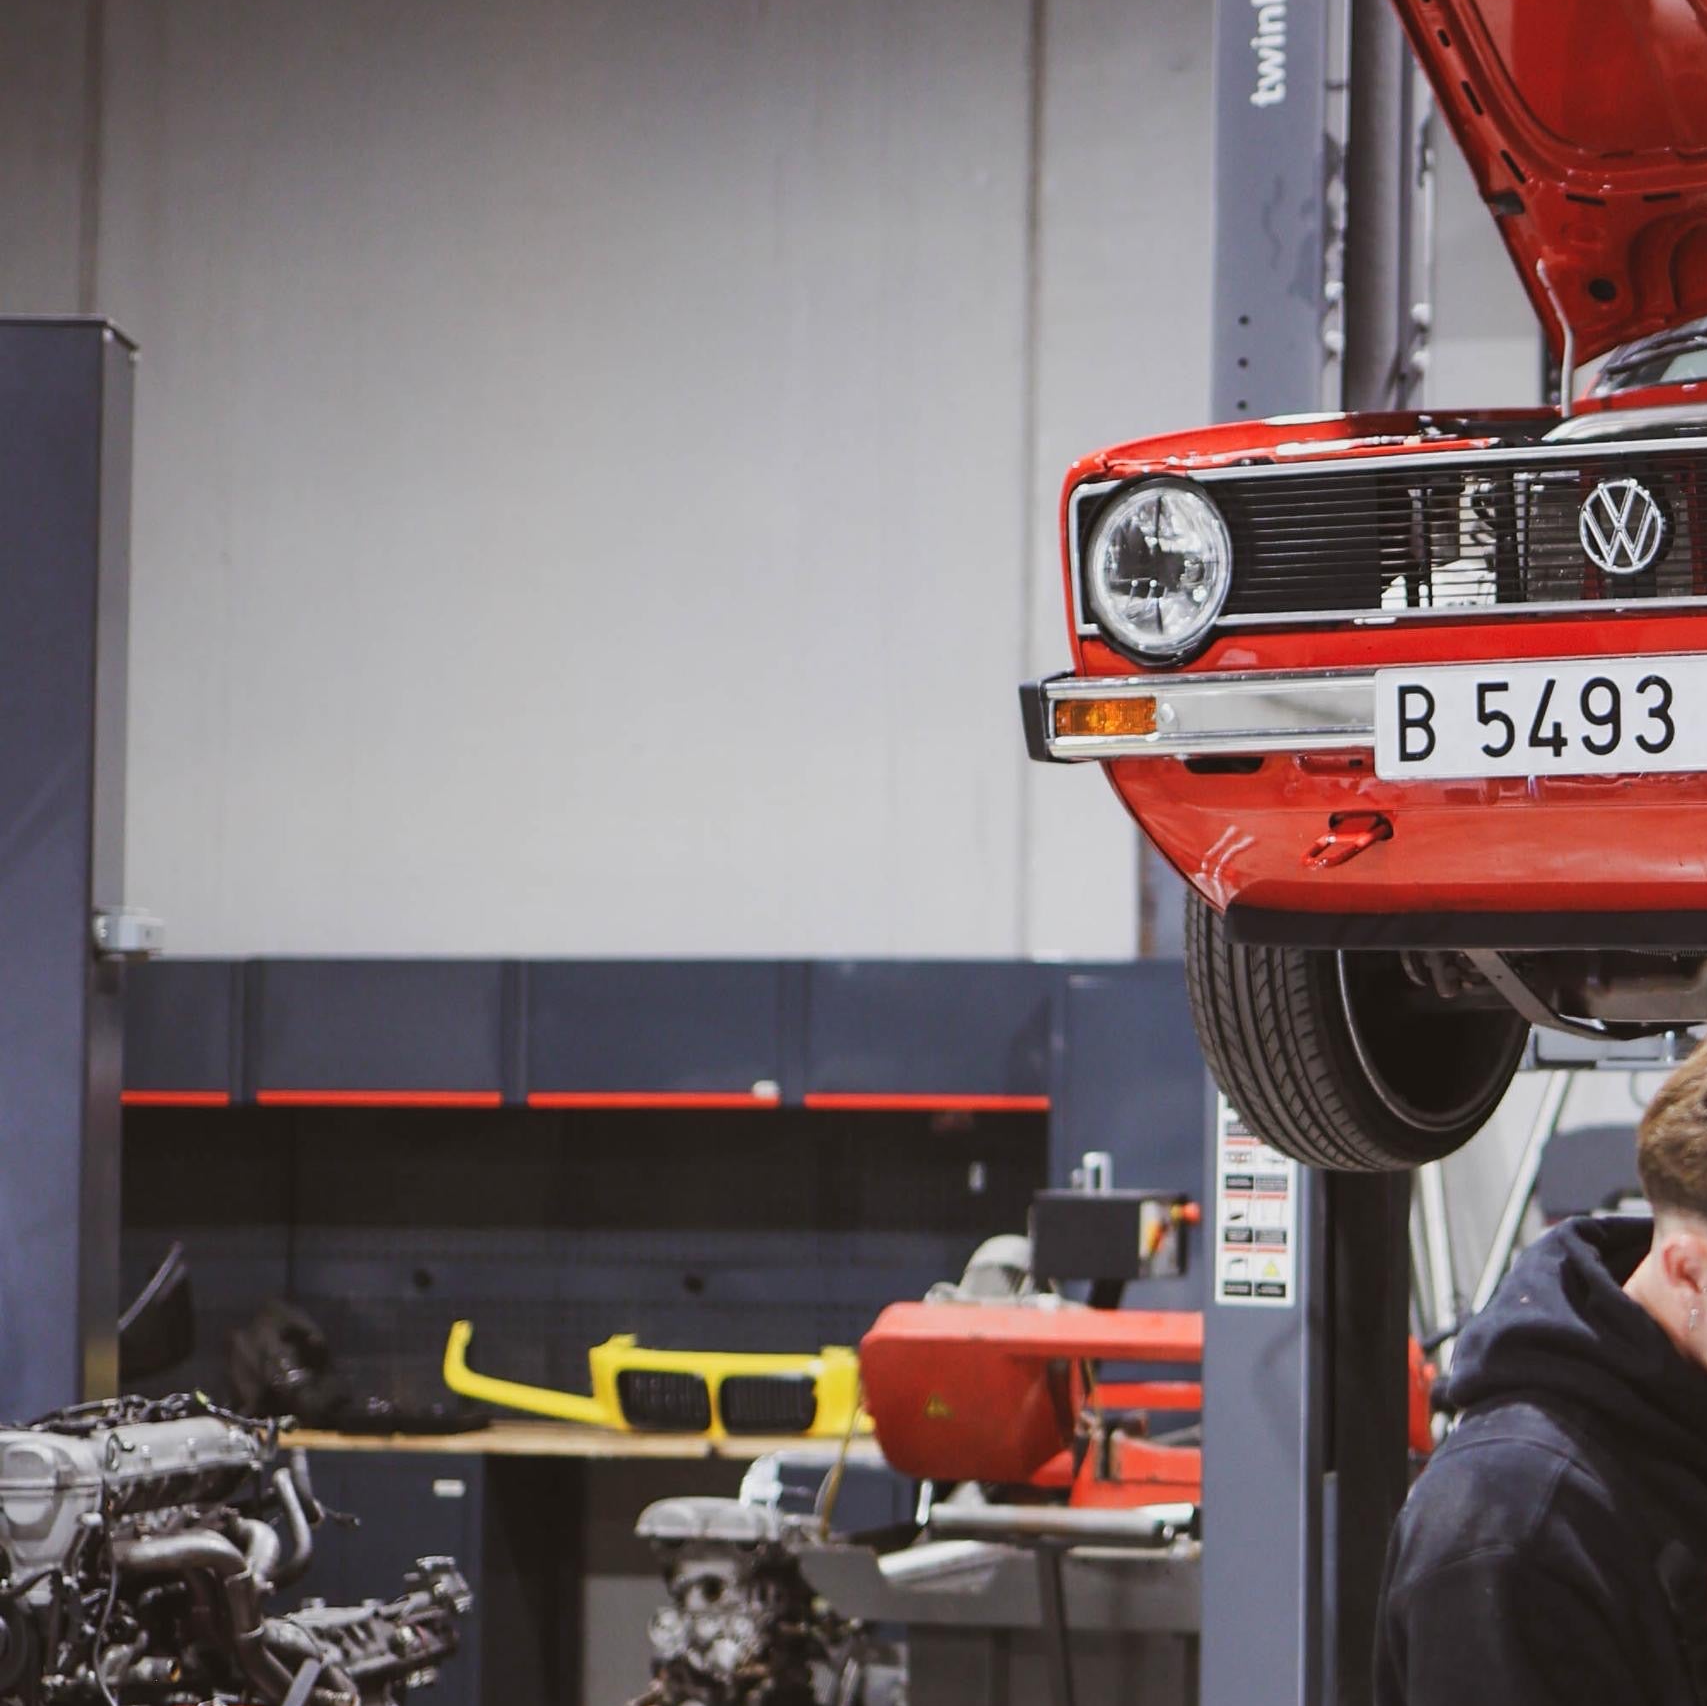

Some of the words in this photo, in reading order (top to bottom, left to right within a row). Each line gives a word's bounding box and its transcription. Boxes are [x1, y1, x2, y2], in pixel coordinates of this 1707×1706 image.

[1579, 477, 1665, 575] VW
[1397, 684, 1436, 762] B
[1475, 674, 1676, 759] 5493
